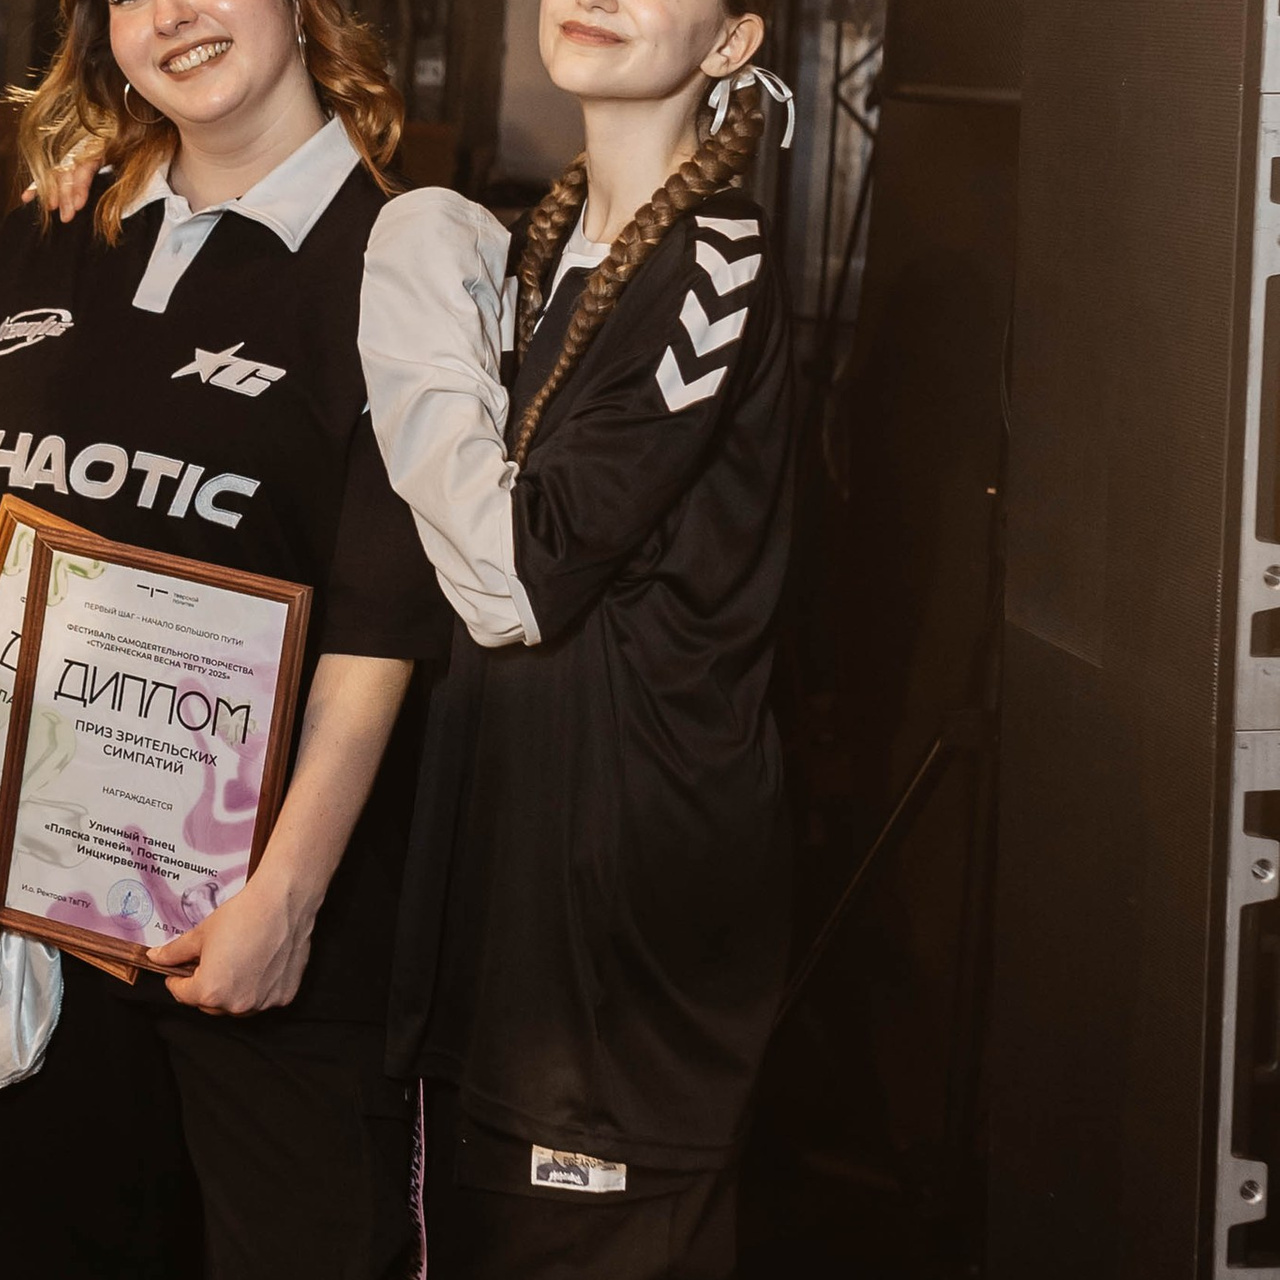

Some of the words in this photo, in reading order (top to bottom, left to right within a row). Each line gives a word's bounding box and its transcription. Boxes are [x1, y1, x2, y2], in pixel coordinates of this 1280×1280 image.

[84, 601, 117, 615] ПЕРВЫЙ
[118, 609, 136, 619] ШАГ
[141, 616, 174, 630] НАЧАЛО
[175, 624, 220, 641] БОЛЬШОГО
[221, 635, 245, 647] ПУТИ!
[67, 623, 116, 641] ФЕСТИВАЛЬ
[117, 635, 200, 662] САМОДЕЯТЕЛЬНОГО
[201, 656, 254, 676] ТВОРЧЕСТВА
[86, 639, 153, 660] «СТУДЕНЧЕСКАЯ
[153, 655, 182, 668] ВЕСНА
[182, 662, 208, 674] ТВГТУ
[53, 658, 251, 745] ДИПЛОМ
[75, 719, 113, 739] ПРИЗ
[115, 729, 218, 767] ЗРИТЕЛЬСКИХ
[103, 744, 184, 775] СИМПАТИЙ
[102, 786, 174, 812] НАГРАЖДАЕТСЯ
[44, 822, 91, 842] «Пляска
[92, 834, 135, 856] теней»,
[136, 847, 218, 878] Постановщик:
[89, 819, 140, 842] Уличный
[142, 835, 176, 853] танец
[76, 843, 148, 872] Инцкирвели
[150, 865, 181, 881] Меги
[36, 888, 68, 902] Ректора
[68, 896, 92, 909] ТвГТУ
